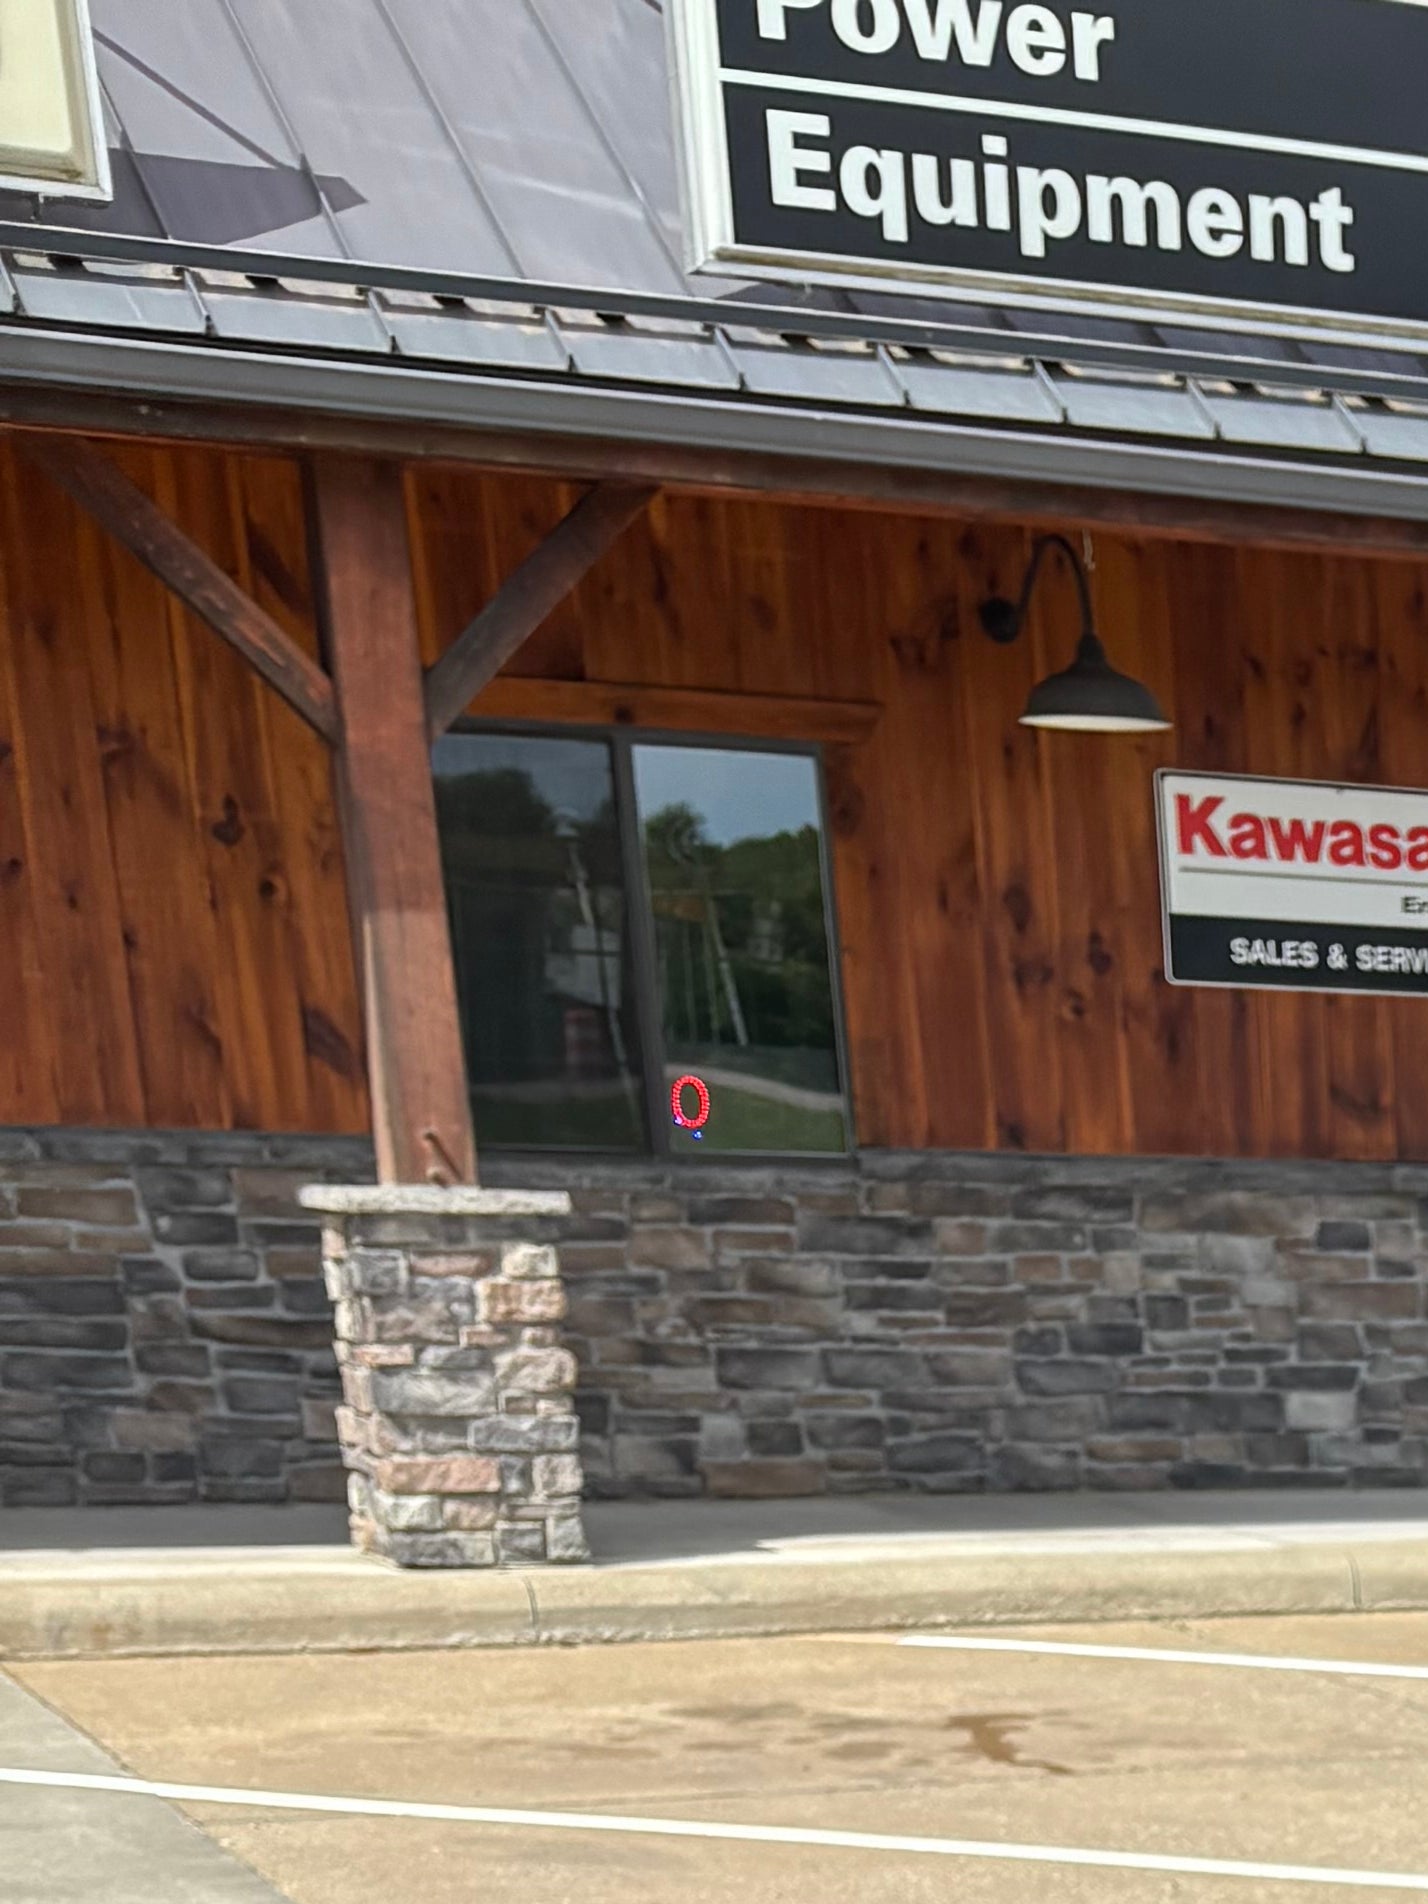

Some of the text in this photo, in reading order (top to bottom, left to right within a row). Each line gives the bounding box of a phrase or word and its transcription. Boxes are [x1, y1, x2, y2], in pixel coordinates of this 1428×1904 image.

[766, 108, 1355, 272] Equipment
[1229, 937, 1319, 968] SALES
[1327, 943, 1348, 970] &
